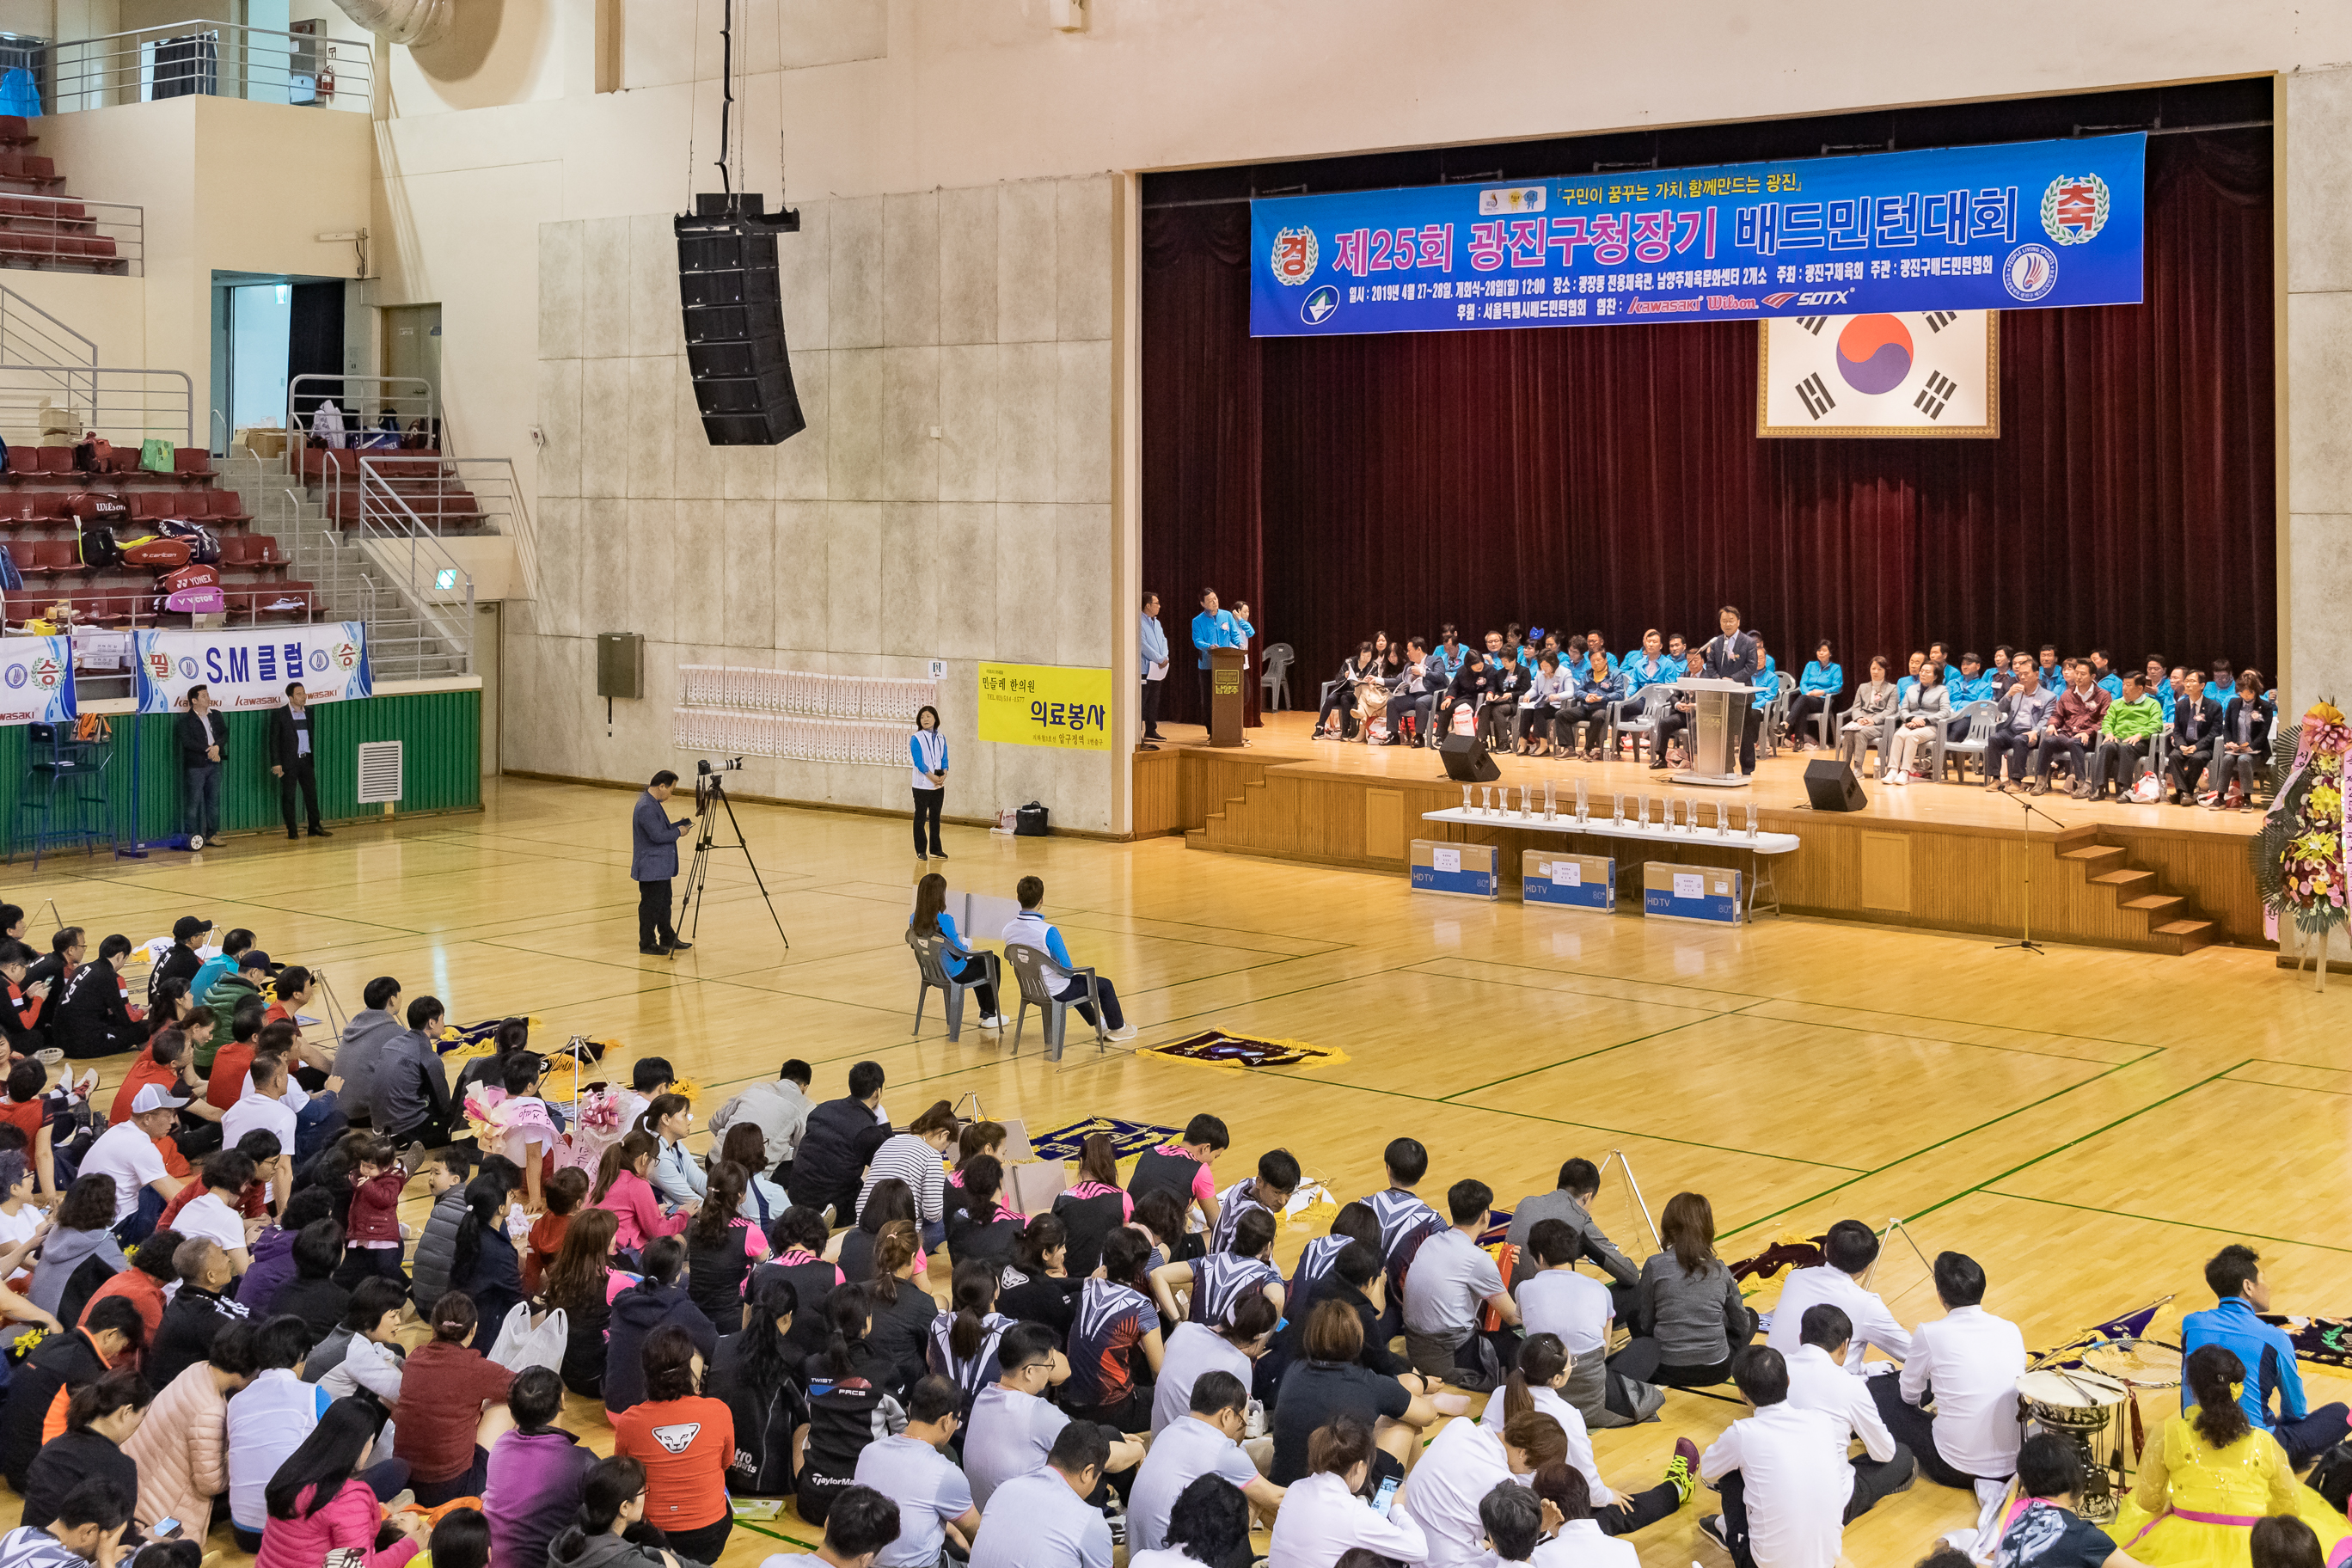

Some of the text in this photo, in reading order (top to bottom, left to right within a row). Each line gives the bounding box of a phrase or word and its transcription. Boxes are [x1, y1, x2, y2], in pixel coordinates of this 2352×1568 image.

[1608, 184, 1650, 204] 꿈꾸는
[2057, 184, 2096, 232] 축
[1332, 186, 2018, 277] 제25회 광진구청장기 배드민턴대회
[1281, 235, 1308, 276] 경
[2006, 250, 2023, 268] PEOPLE
[2040, 248, 2055, 266] SPORTS
[1349, 286, 1365, 303] 일시
[1371, 285, 1400, 302] 2019년
[1401, 284, 1415, 301] 4월
[1522, 278, 1546, 295] 12:00
[1553, 276, 1571, 294] 장소
[1578, 274, 1605, 294] 광장동
[1657, 267, 1740, 290] 남양주체육문화센터
[1742, 266, 1767, 285] 2개소
[1776, 265, 1797, 285] 주최
[1804, 261, 1865, 283] 광진구체육회
[1870, 260, 1891, 279] 주관
[1900, 255, 1994, 278] 광진구배드민턴협회
[1456, 303, 1476, 321] 후원
[1483, 299, 1587, 321] 서울특별시배드민턴협회
[1596, 297, 1617, 316] 협찬
[1797, 291, 1850, 306] SOTX
[96, 502, 126, 512] Wilson
[189, 574, 213, 587] YONEX
[187, 595, 214, 603] VCTOR
[150, 653, 169, 678] 필
[205, 647, 250, 684] S.M
[338, 643, 356, 667] 승
[37, 659, 59, 686] 승
[983, 677, 1035, 694] 민들레 한의원
[174, 695, 223, 707] kaaki
[1031, 701, 1106, 732] 의료봉사
[1058, 733, 1085, 746] 압구정역
